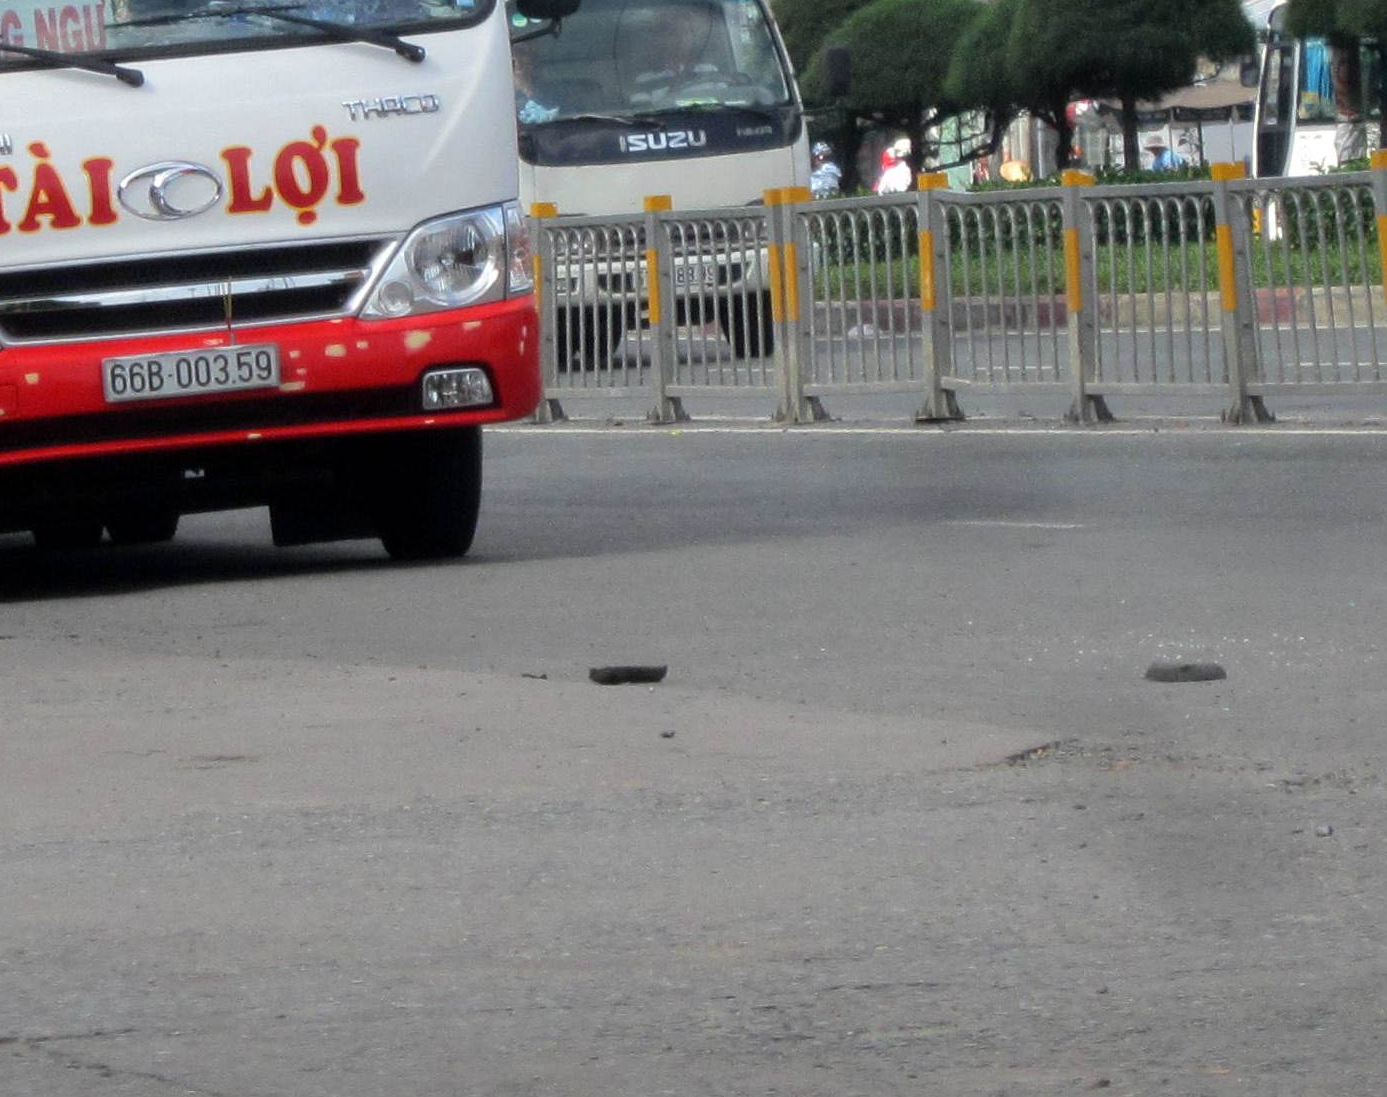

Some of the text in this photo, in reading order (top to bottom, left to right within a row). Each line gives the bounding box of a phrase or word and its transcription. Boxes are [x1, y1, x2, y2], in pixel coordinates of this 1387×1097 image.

[341, 92, 442, 121] THACO
[618, 129, 708, 153] ISUZU
[220, 123, 366, 226] LỢI
